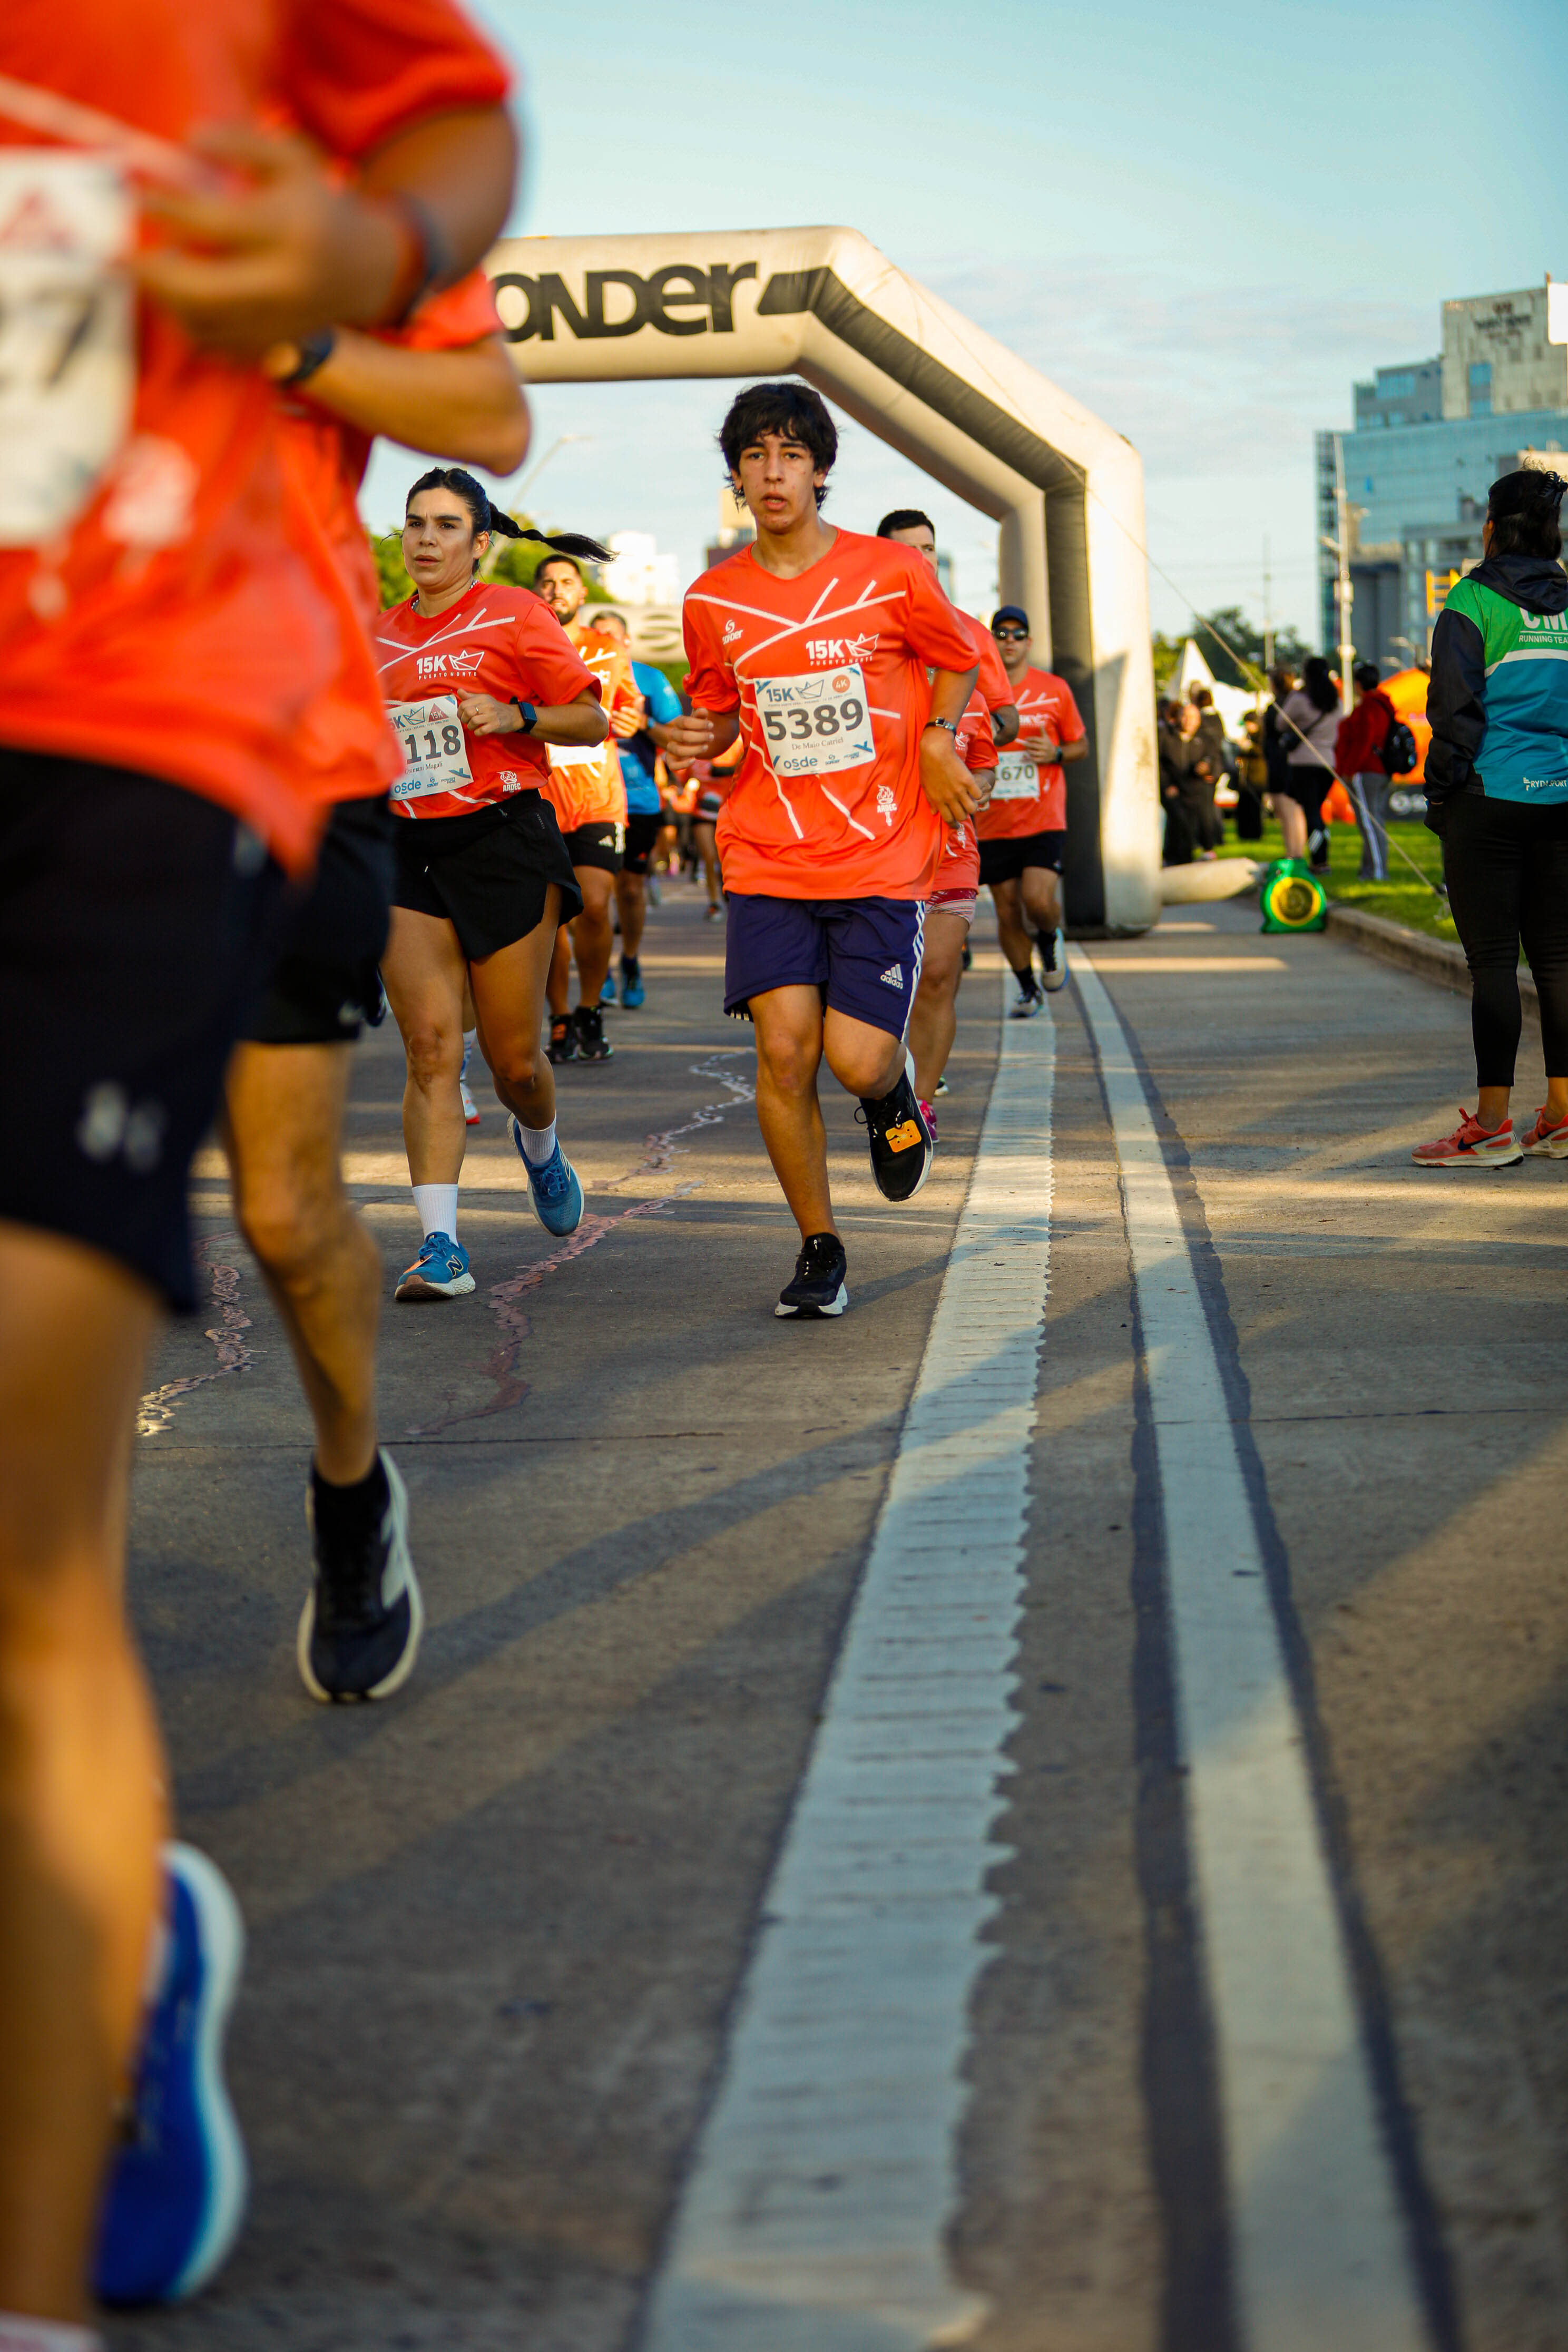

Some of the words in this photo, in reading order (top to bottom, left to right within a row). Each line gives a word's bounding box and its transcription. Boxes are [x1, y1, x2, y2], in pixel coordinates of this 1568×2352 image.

[806, 639, 845, 660] 15K
[416, 654, 447, 674] 15K
[418, 672, 447, 680] PUERTO
[766, 687, 795, 702] 15K
[835, 679, 848, 689] 4K
[430, 710, 444, 720] 15K
[764, 698, 863, 741] 5389
[405, 725, 461, 764] 118
[821, 737, 844, 746] Catriel
[425, 761, 443, 771] Magali
[783, 756, 818, 770] osde
[395, 779, 422, 794] osde
[503, 783, 521, 792] ARDEC
[877, 803, 898, 814] ARDEC
[880, 974, 903, 989] adidas
